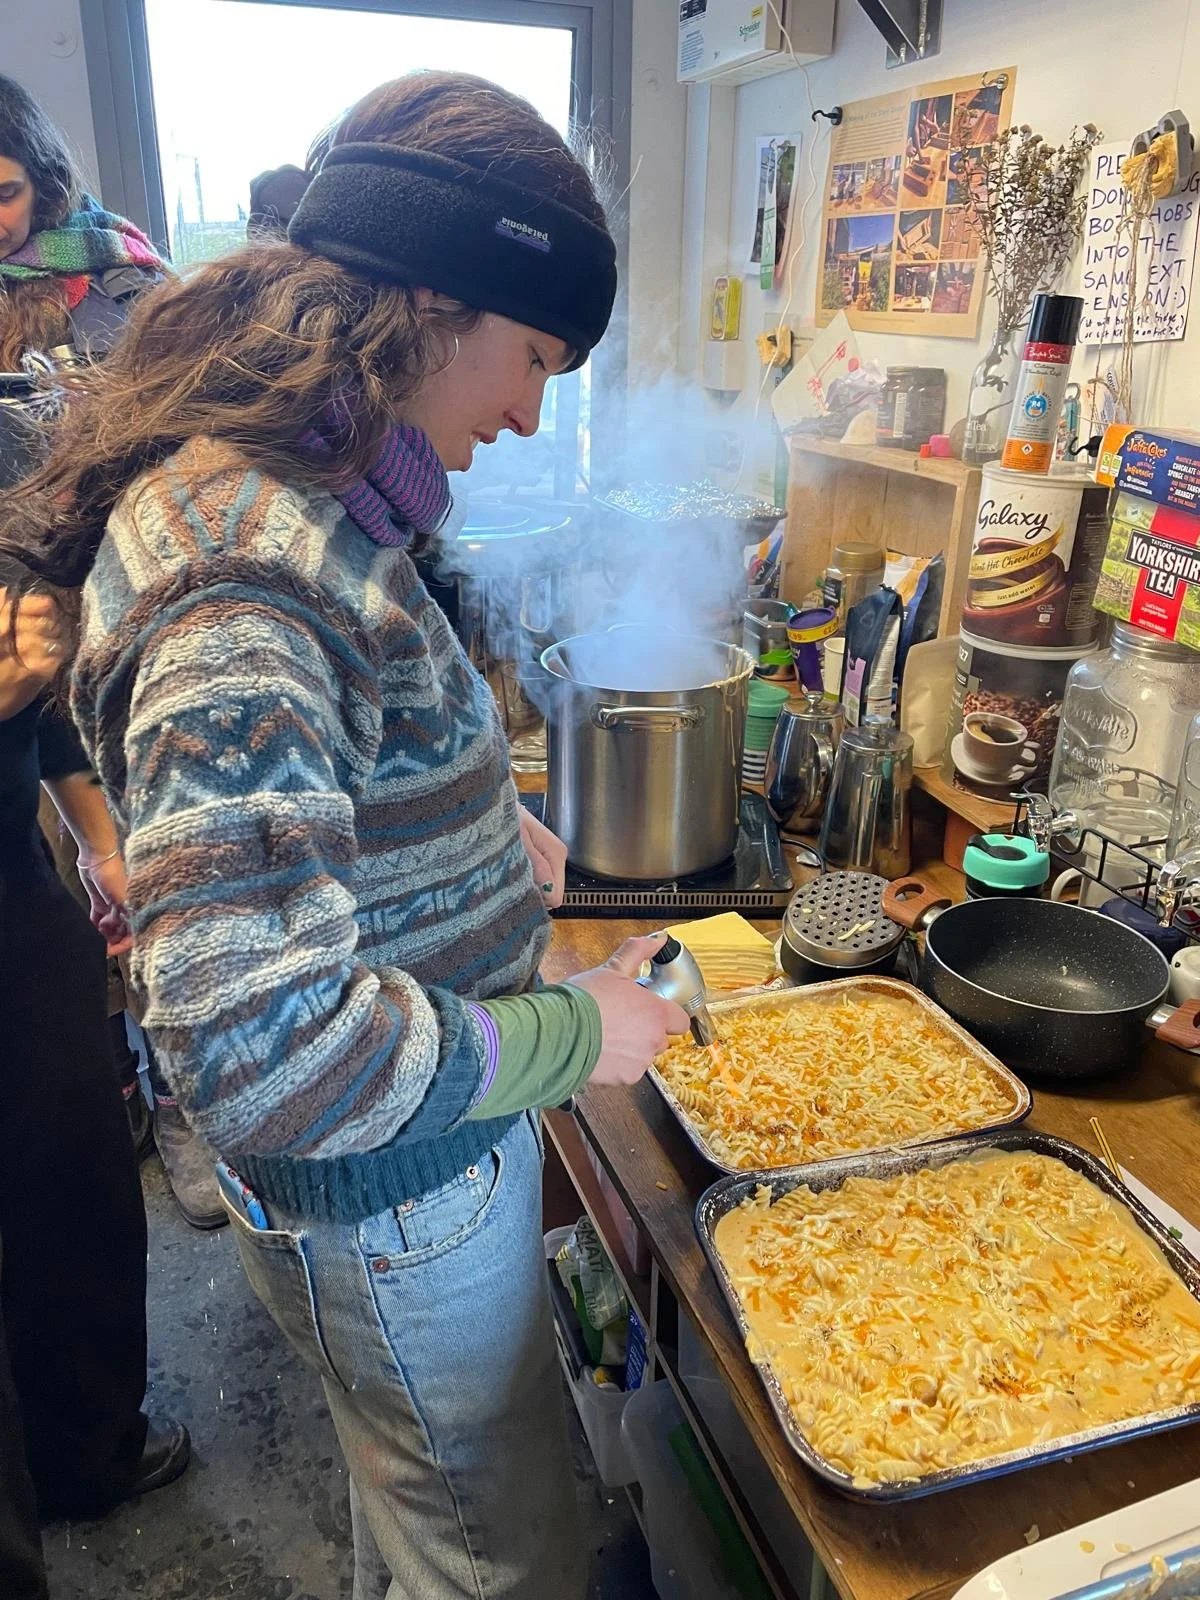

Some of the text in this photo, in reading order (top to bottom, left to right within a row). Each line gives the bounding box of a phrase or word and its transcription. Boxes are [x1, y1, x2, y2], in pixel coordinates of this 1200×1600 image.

[501, 216, 549, 242] patagonia
[1087, 233, 1179, 265] INTO THE
[1149, 259, 1186, 285] EXT
[979, 500, 1052, 539] Galaxy
[1151, 538, 1172, 550] TAYLORS
[986, 561, 1000, 571] Hot
[1001, 548, 1043, 568] Chocolate
[1130, 536, 1200, 582] YORKSHIR
[1148, 568, 1176, 595] TEA
